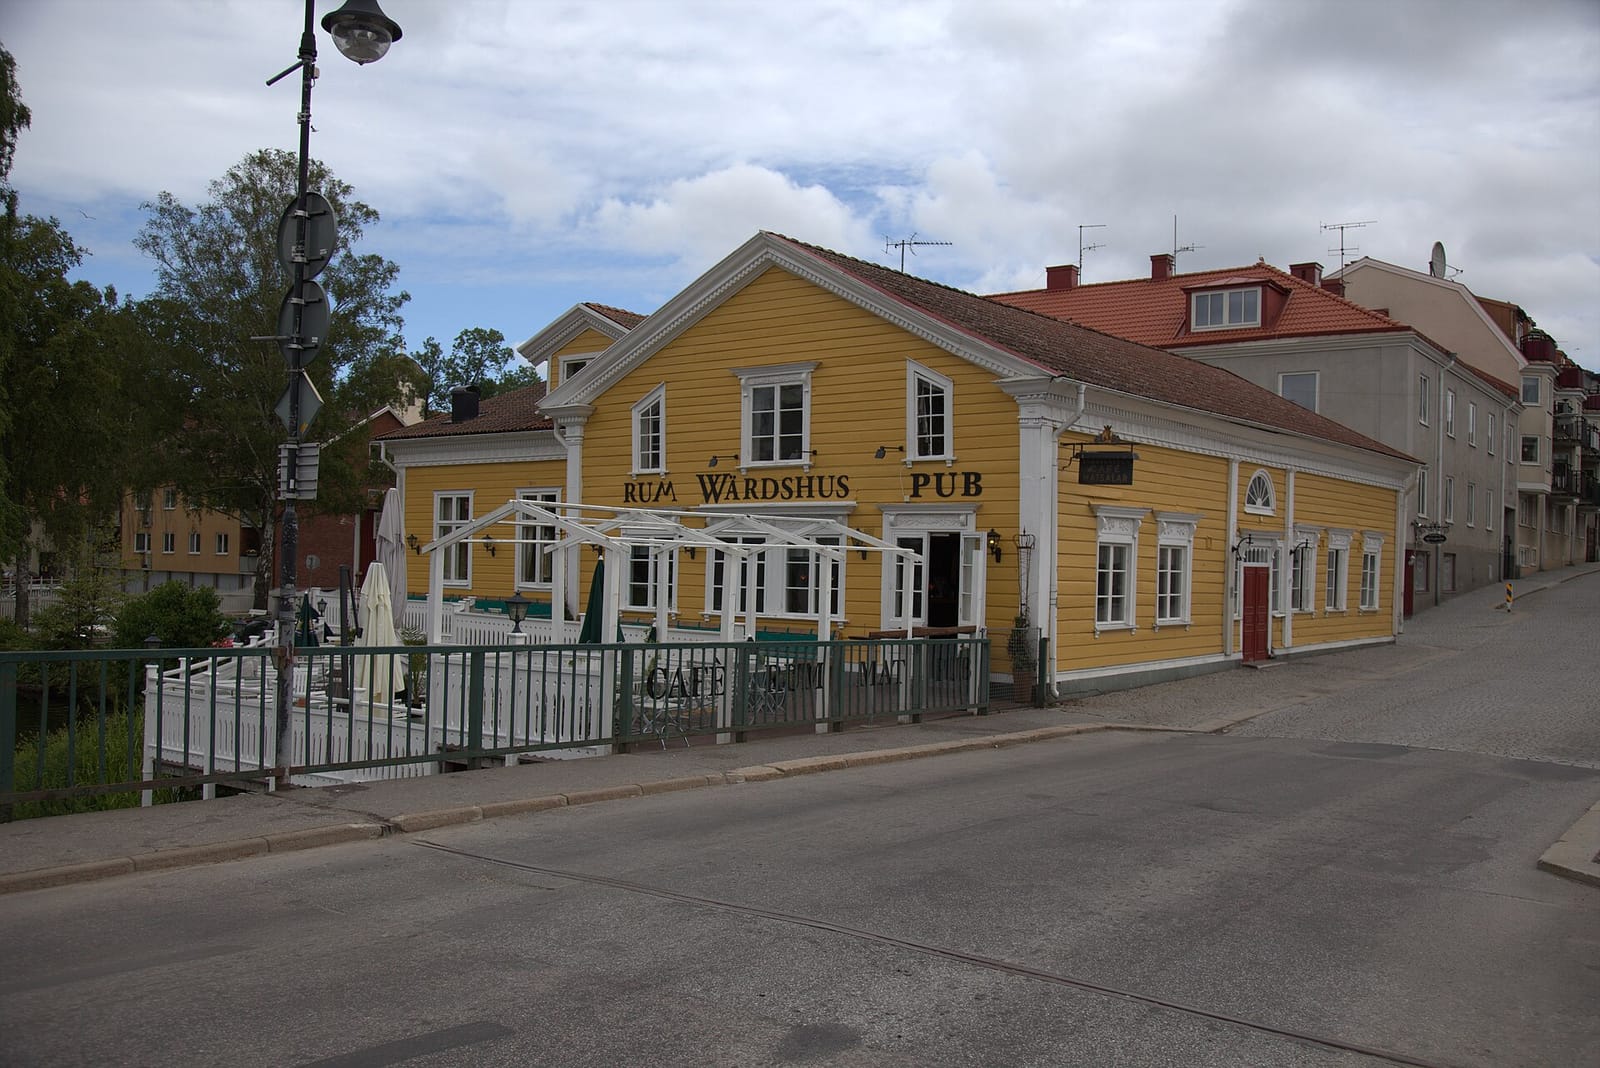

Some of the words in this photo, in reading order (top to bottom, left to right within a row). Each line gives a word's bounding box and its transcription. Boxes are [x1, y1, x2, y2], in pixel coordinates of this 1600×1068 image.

[623, 481, 678, 503] RUM
[696, 473, 850, 504] WÄRDSHUS
[910, 471, 983, 498] PUB
[857, 659, 906, 688] MAT
